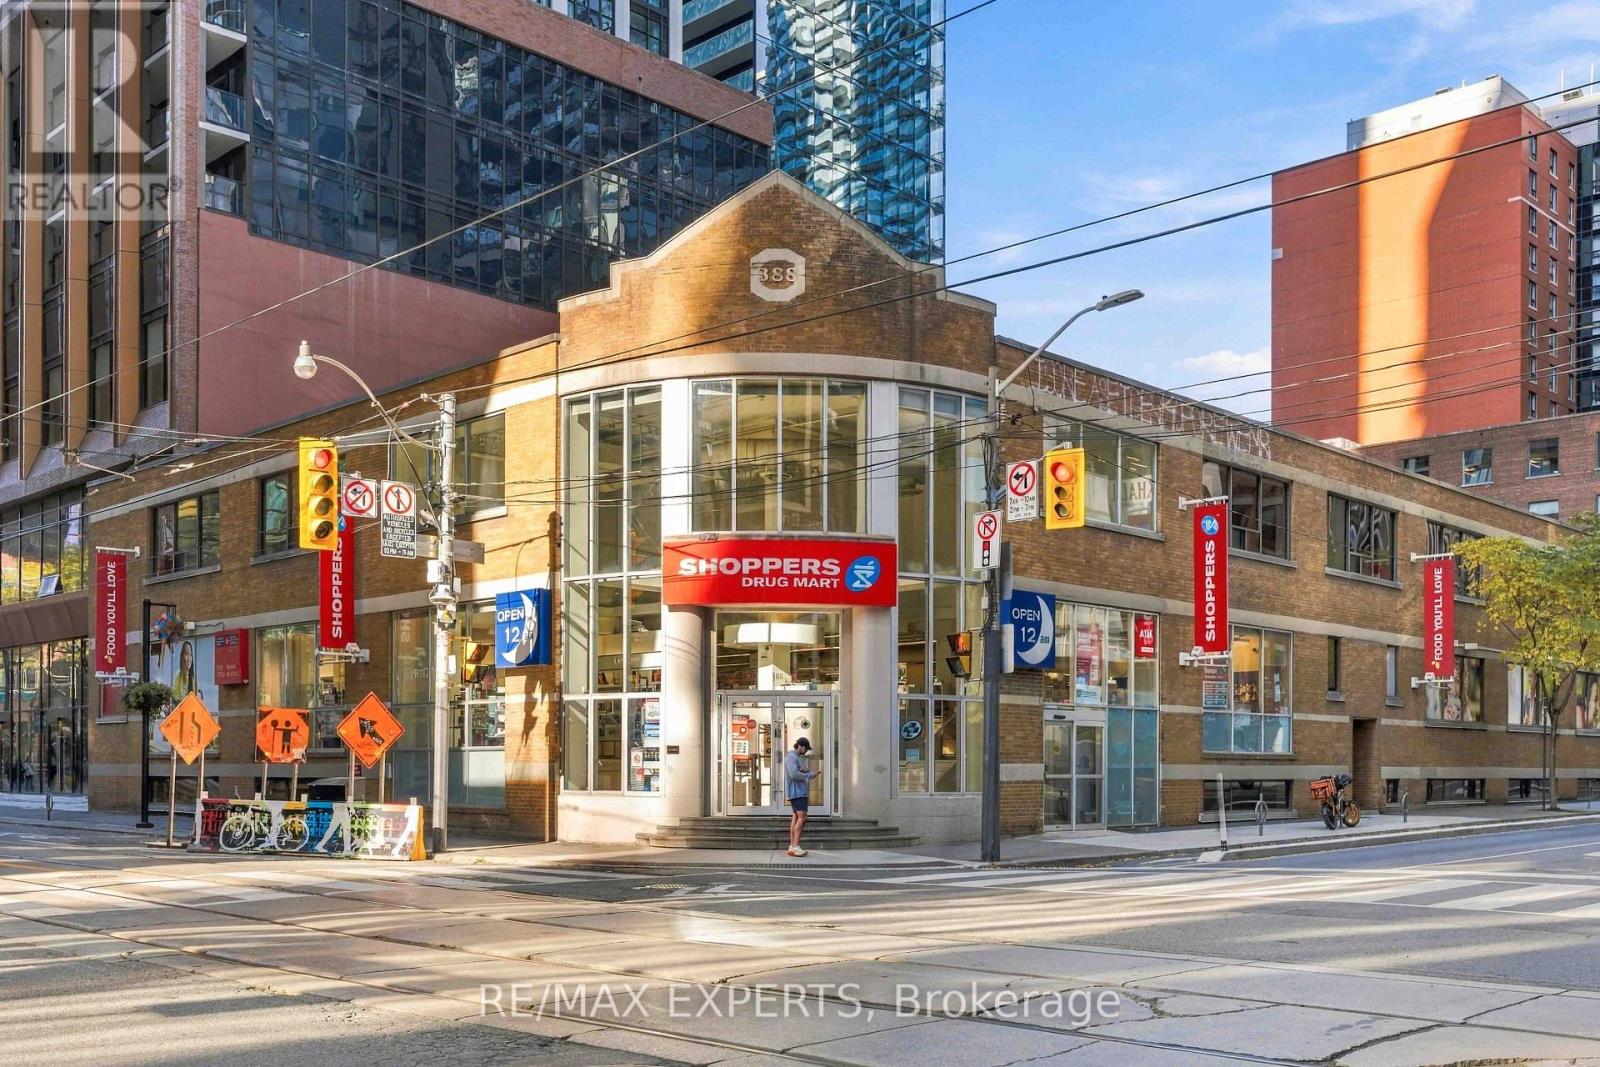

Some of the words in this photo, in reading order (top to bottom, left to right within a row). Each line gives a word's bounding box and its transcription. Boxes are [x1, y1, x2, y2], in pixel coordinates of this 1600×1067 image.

[760, 267, 796, 282] 388
[107, 561, 116, 588] LOVE
[678, 557, 840, 576] SHOPPERS
[742, 577, 788, 588] DRUG
[793, 577, 840, 589] MART
[1205, 540, 1216, 642] SHOPPERS
[1434, 567, 1443, 594] LOVE
[107, 590, 116, 625] YOU'LL
[497, 608, 525, 623] OPEN
[1012, 607, 1041, 621] OPEN
[1434, 595, 1443, 631] YOU'LL
[107, 627, 116, 656] FOOD
[505, 626, 520, 644] 12
[1020, 627, 1036, 643] 12
[1434, 633, 1443, 661] FOOD
